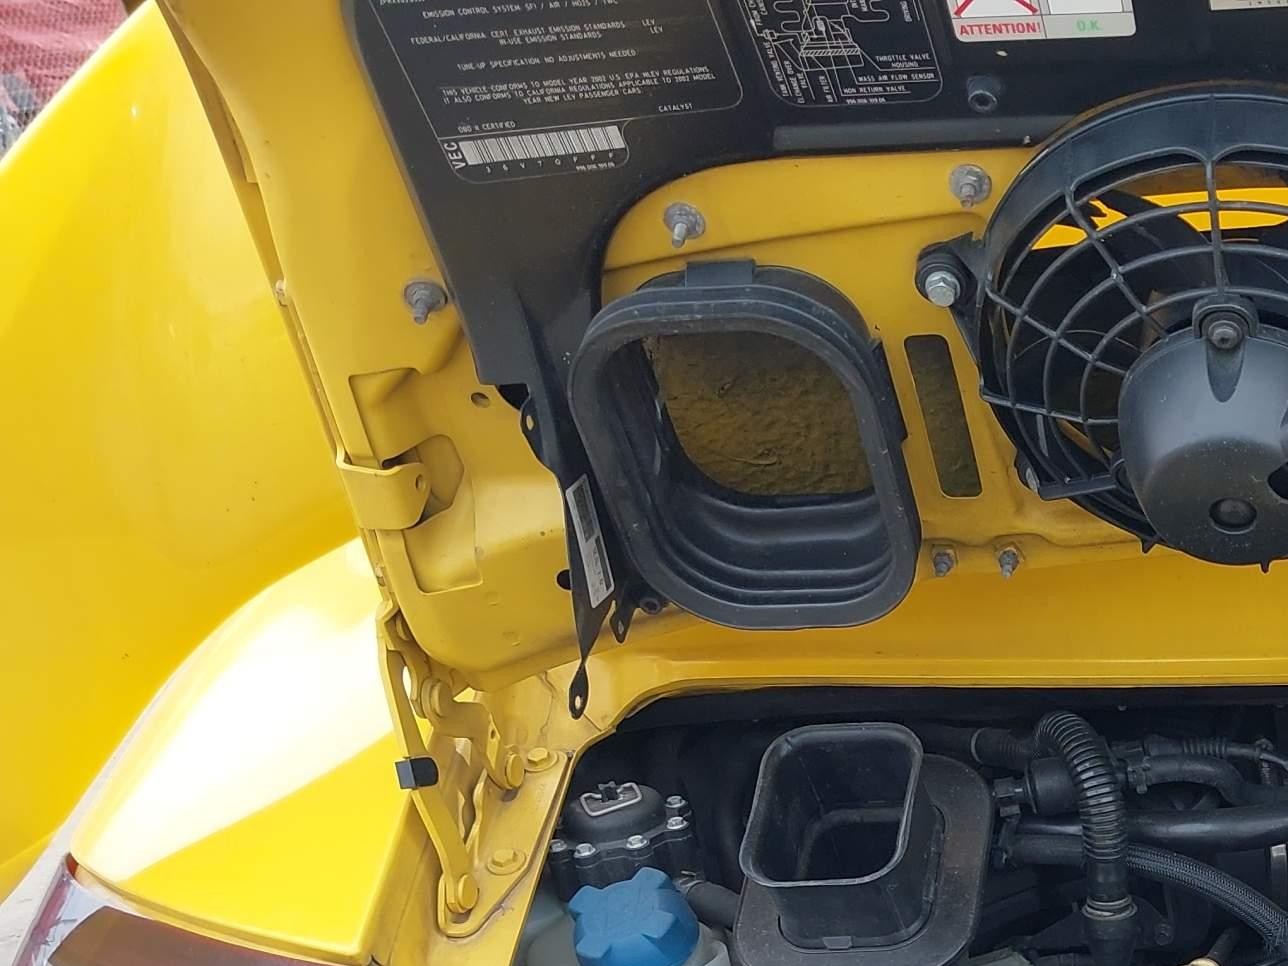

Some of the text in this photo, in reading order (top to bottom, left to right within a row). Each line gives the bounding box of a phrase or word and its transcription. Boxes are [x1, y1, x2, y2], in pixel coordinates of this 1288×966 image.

[422, 10, 455, 19] EMISSION
[457, 7, 490, 16] CONTROL
[493, 4, 521, 13] SYSTEM
[550, 1, 561, 9] AIR
[513, 26, 545, 36] EXHAUST
[548, 24, 580, 34] EMISSION
[584, 21, 626, 31] STANDARDS
[641, 19, 656, 27] LEV
[960, 22, 1041, 36] ATTENTION!
[499, 26, 663, 46] IN-USE EMISSION STANDARDS LEV
[457, 62, 485, 71] TUNE-UP
[489, 57, 541, 68] SPECIFICATION
[558, 52, 606, 62] ADJUSTMENTS
[875, 53, 931, 62] THROTTLE VALVE
[461, 87, 486, 95] VEHICLE
[490, 82, 528, 92] CONFORMS
[543, 78, 566, 86] MODEL
[568, 77, 590, 86] YEAR
[625, 72, 639, 80] EPA
[662, 66, 710, 76] REGULATIONS
[858, 74, 875, 82] MASS
[890, 73, 908, 81] FLOW
[475, 91, 512, 101] CONFORMS
[526, 85, 566, 96] CALIFORNIA
[568, 82, 615, 92] REGULATIONS
[618, 78, 659, 88] APPLICABLE
[693, 72, 716, 81] MODEL
[860, 86, 884, 94] RETURN
[523, 97, 541, 105] YEAR
[544, 95, 560, 103] NEW
[563, 93, 576, 101] LEV
[579, 89, 619, 99] PASSENGER
[658, 103, 693, 113] CATALYST
[481, 121, 516, 130] CERTIFIED
[444, 141, 467, 170] VEC
